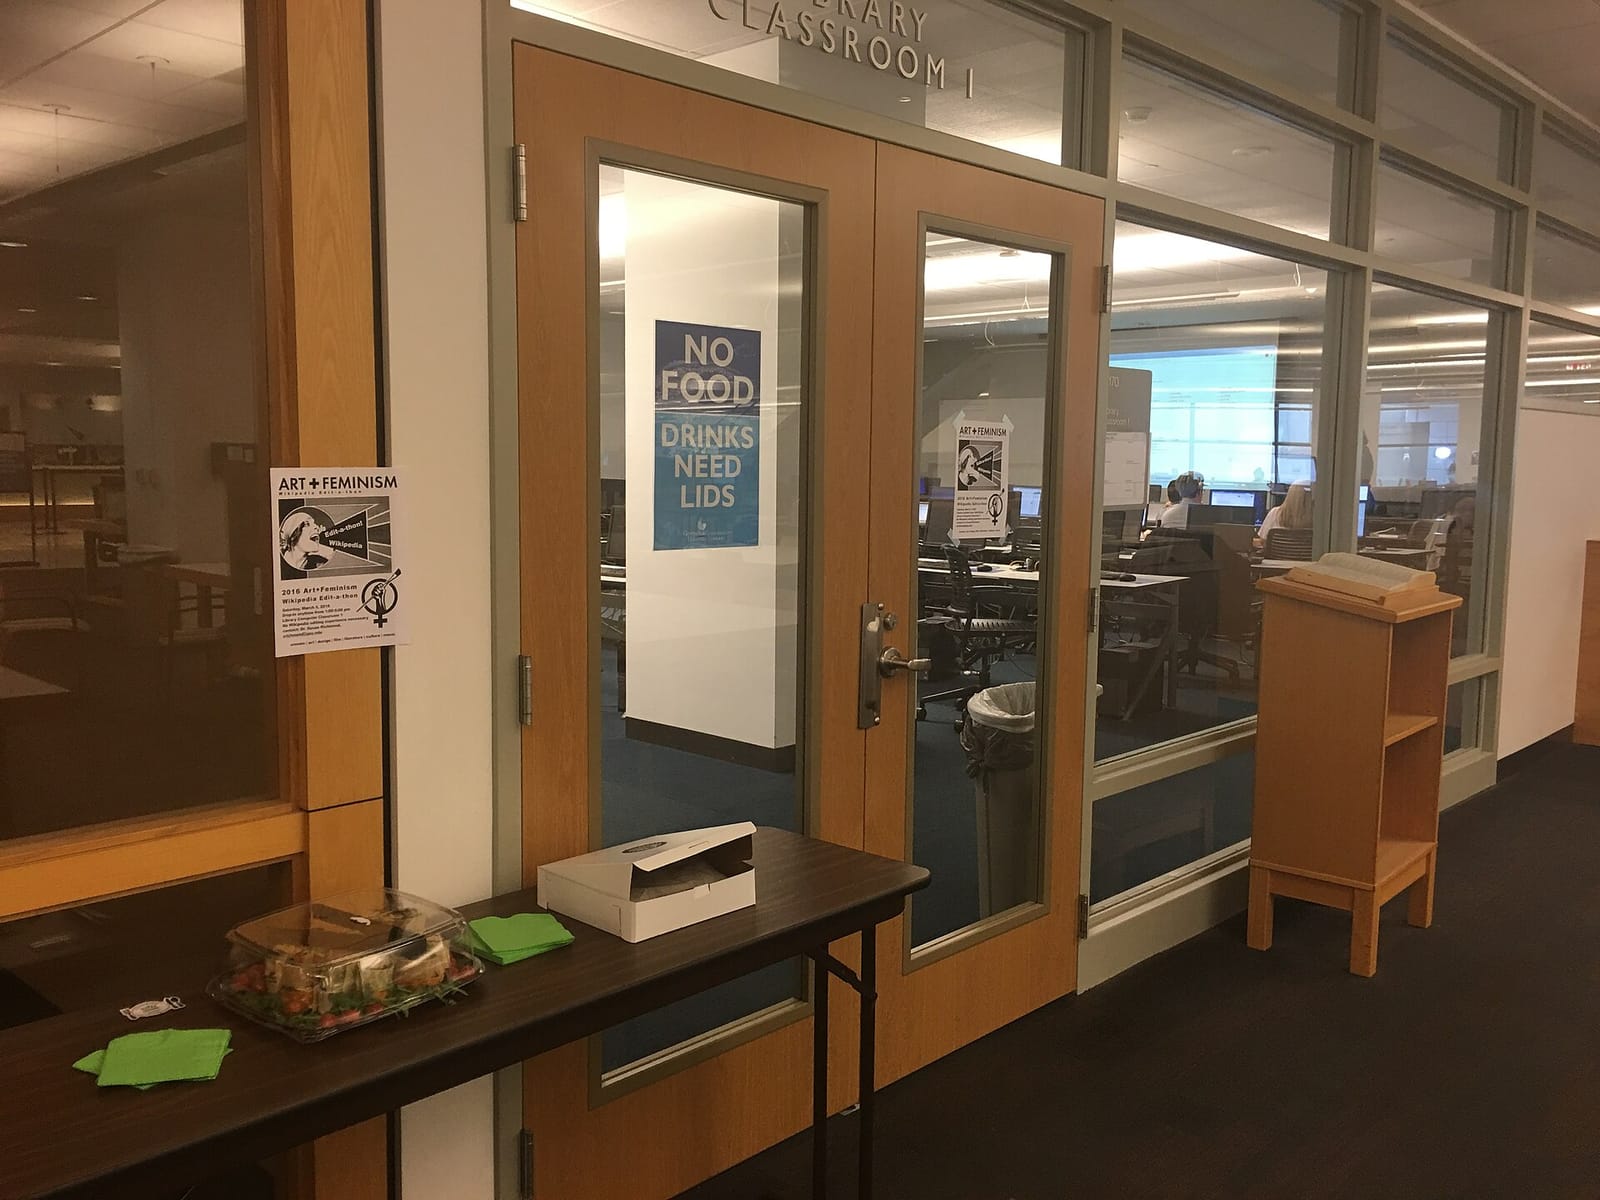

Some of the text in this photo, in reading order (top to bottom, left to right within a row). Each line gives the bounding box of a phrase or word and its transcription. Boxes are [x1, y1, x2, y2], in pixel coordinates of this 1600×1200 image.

[707, 0, 945, 89] CLASSROOM
[684, 333, 734, 367] NO
[661, 369, 754, 405] FOOD
[661, 423, 754, 449] DRINKS
[674, 454, 742, 478] NEED
[680, 484, 735, 509] LIDS
[328, 539, 363, 549] Wikipedia
[281, 588, 301, 596] 2016
[282, 593, 359, 605] Wikipedia Edit-a-thon
